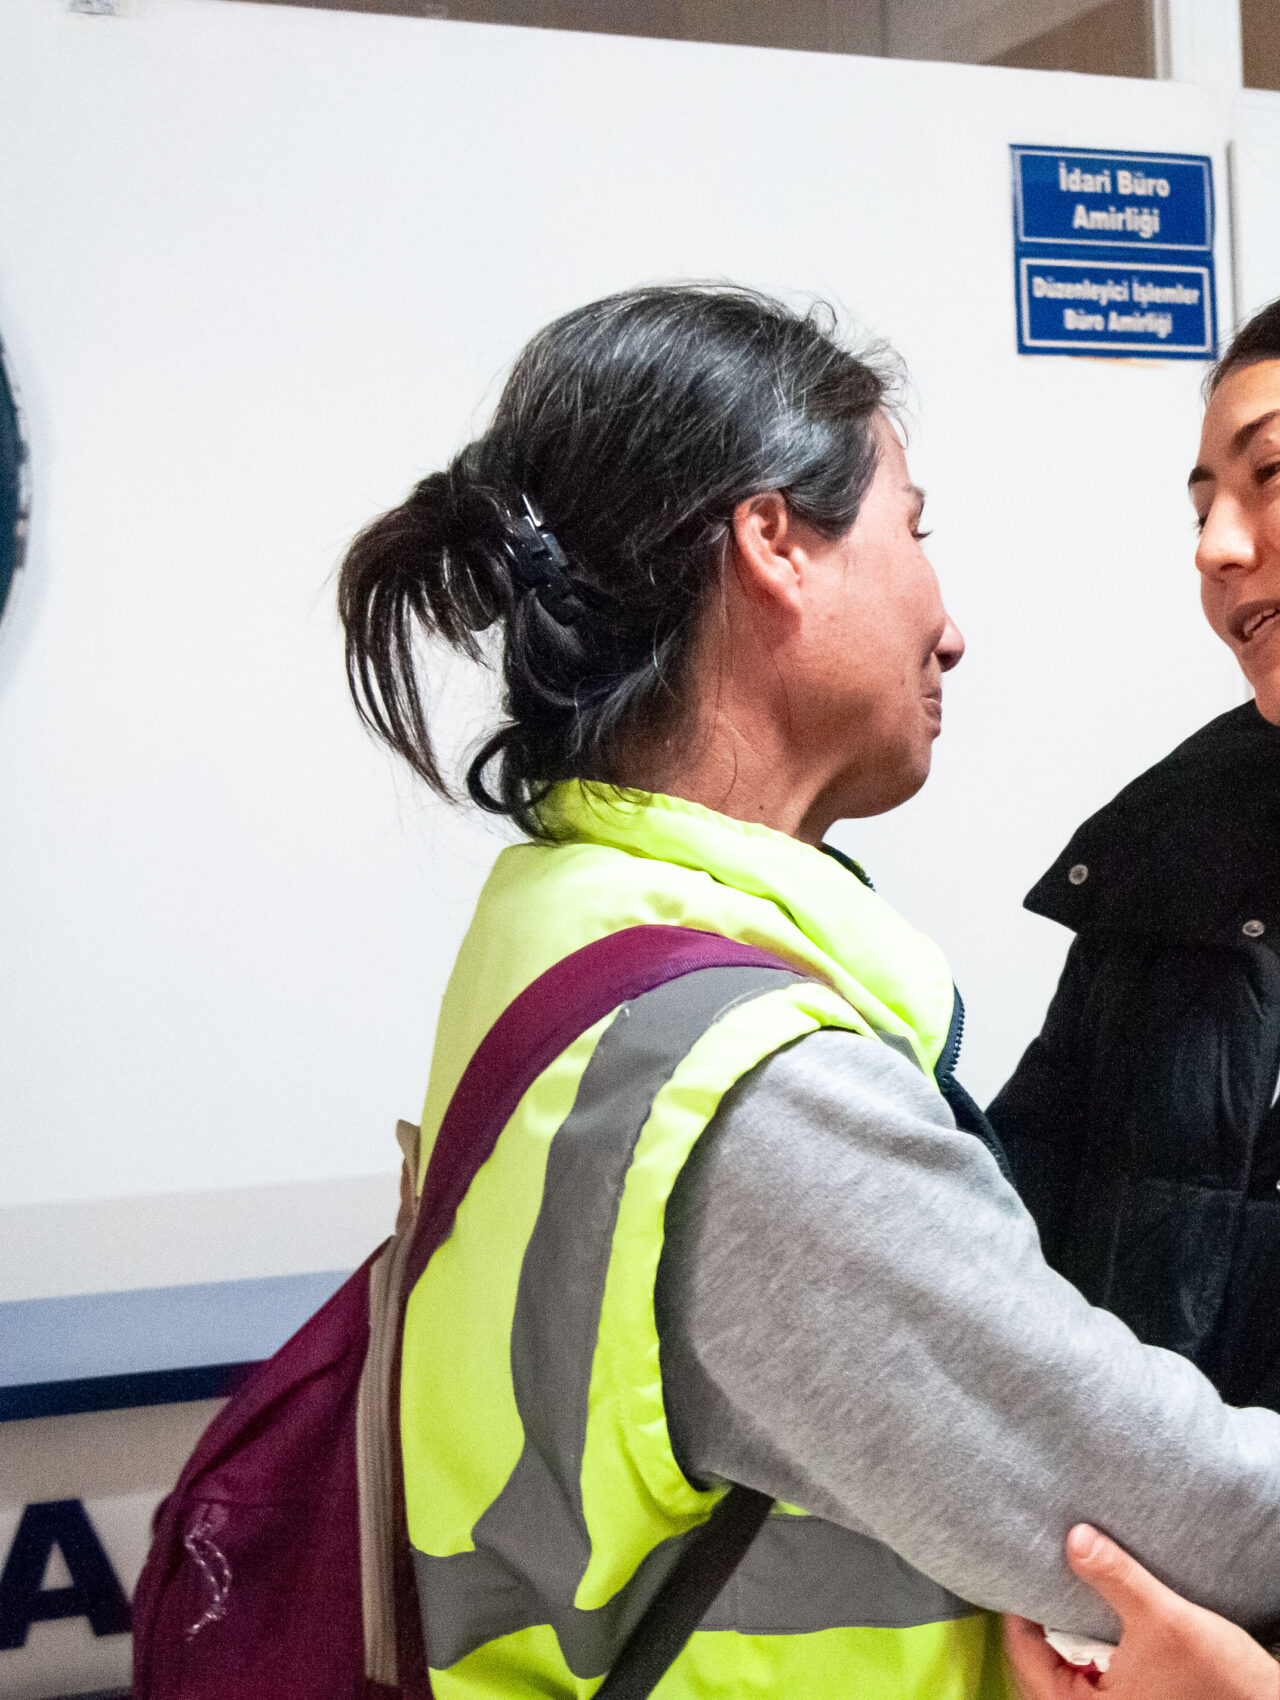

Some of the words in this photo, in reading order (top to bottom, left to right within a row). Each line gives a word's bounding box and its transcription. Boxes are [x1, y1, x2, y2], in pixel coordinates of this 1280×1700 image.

[1059, 162, 1111, 192] İdari
[1117, 172, 1169, 197] Büro
[1073, 206, 1159, 238] Amirliği
[1063, 310, 1104, 330] Büro
[1108, 313, 1172, 338] Amirliği
